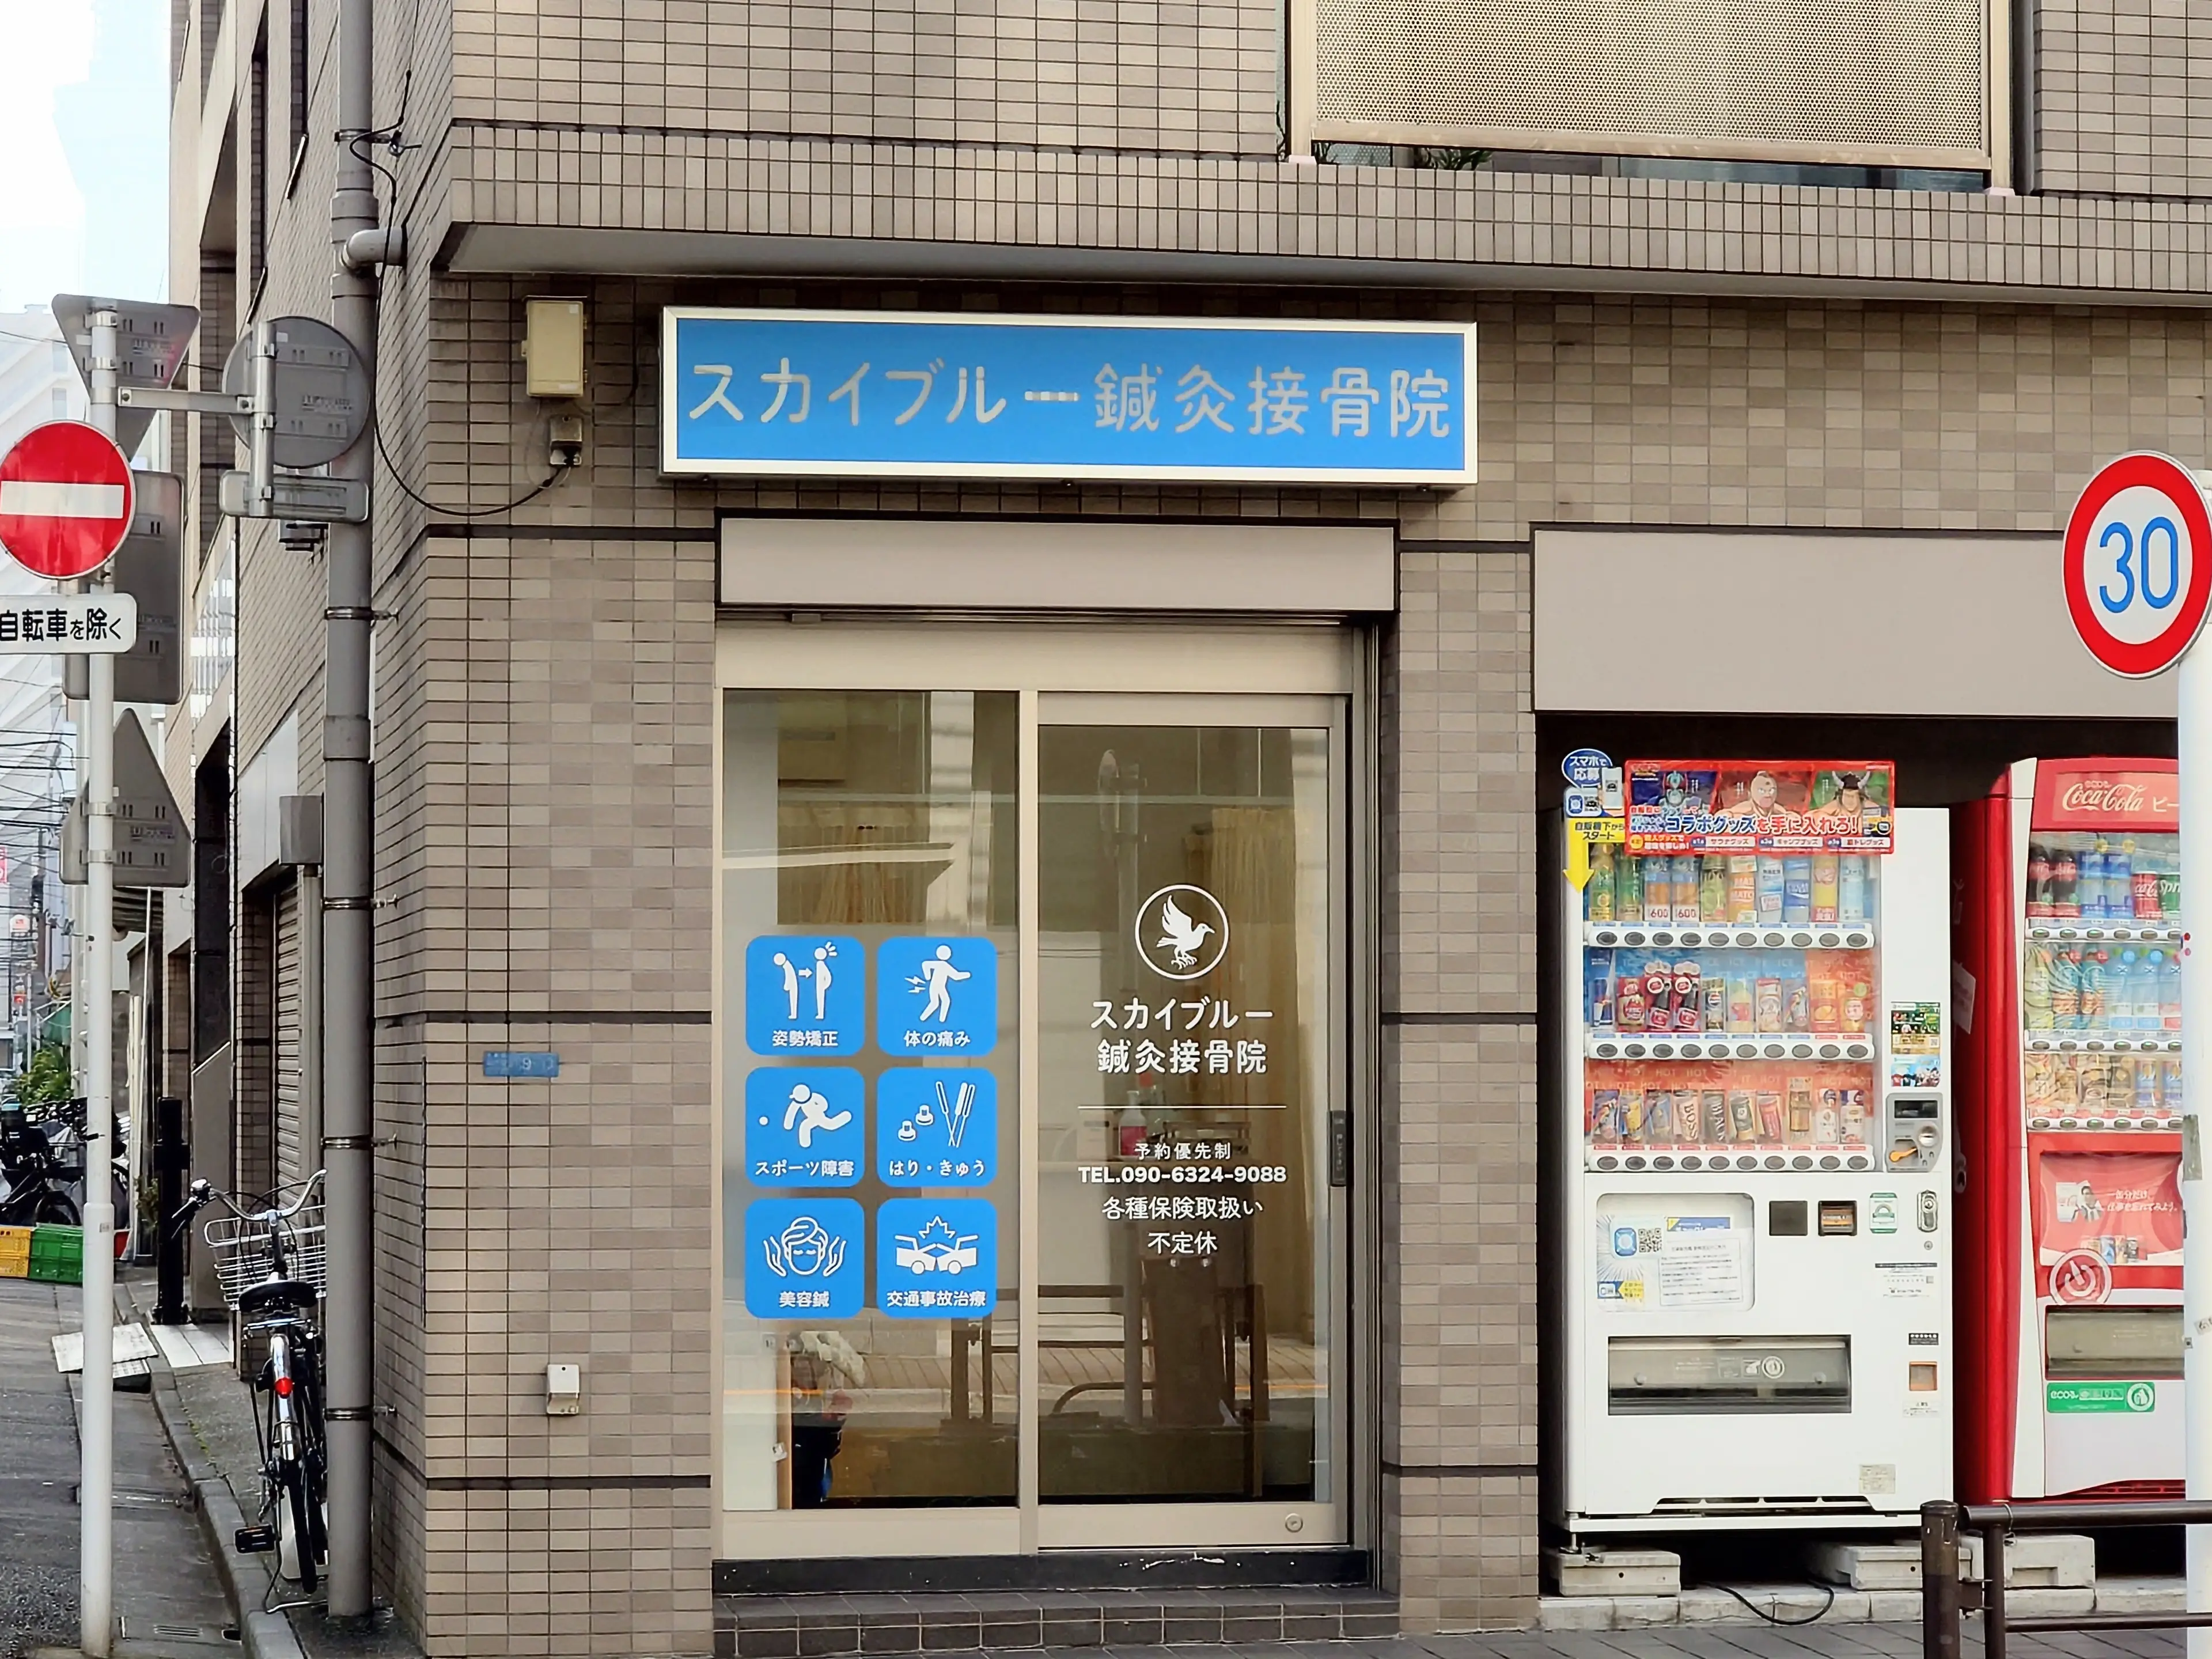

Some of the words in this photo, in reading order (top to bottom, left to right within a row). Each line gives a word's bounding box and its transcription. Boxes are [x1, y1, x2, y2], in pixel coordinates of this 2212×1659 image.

[690, 357, 1449, 438] スカイブルー鍼灸接骨院
[2099, 517, 2179, 613] 30
[0, 608, 121, 642] 自転車を除く
[1583, 832, 1615, 840] スタート
[1090, 996, 1273, 1031] スカイブルー
[772, 1030, 839, 1047] 姿勢矯正
[904, 1030, 971, 1047] 体の痛み
[1097, 1039, 1267, 1074] 鍼灸接骨院
[1684, 1104, 1698, 1139] BOSS
[1134, 1142, 1231, 1160] 予約優先制
[755, 1159, 855, 1177] スポーツ障害
[889, 1159, 985, 1176] はり・きゅう
[1078, 1166, 1287, 1183] TEL.090-6324-9088
[1102, 1196, 1264, 1220] 各種保険取扱い
[1147, 1230, 1218, 1254] 不定休
[779, 1290, 831, 1308] 美容鍼
[887, 1290, 986, 1308] 交通事故治療
